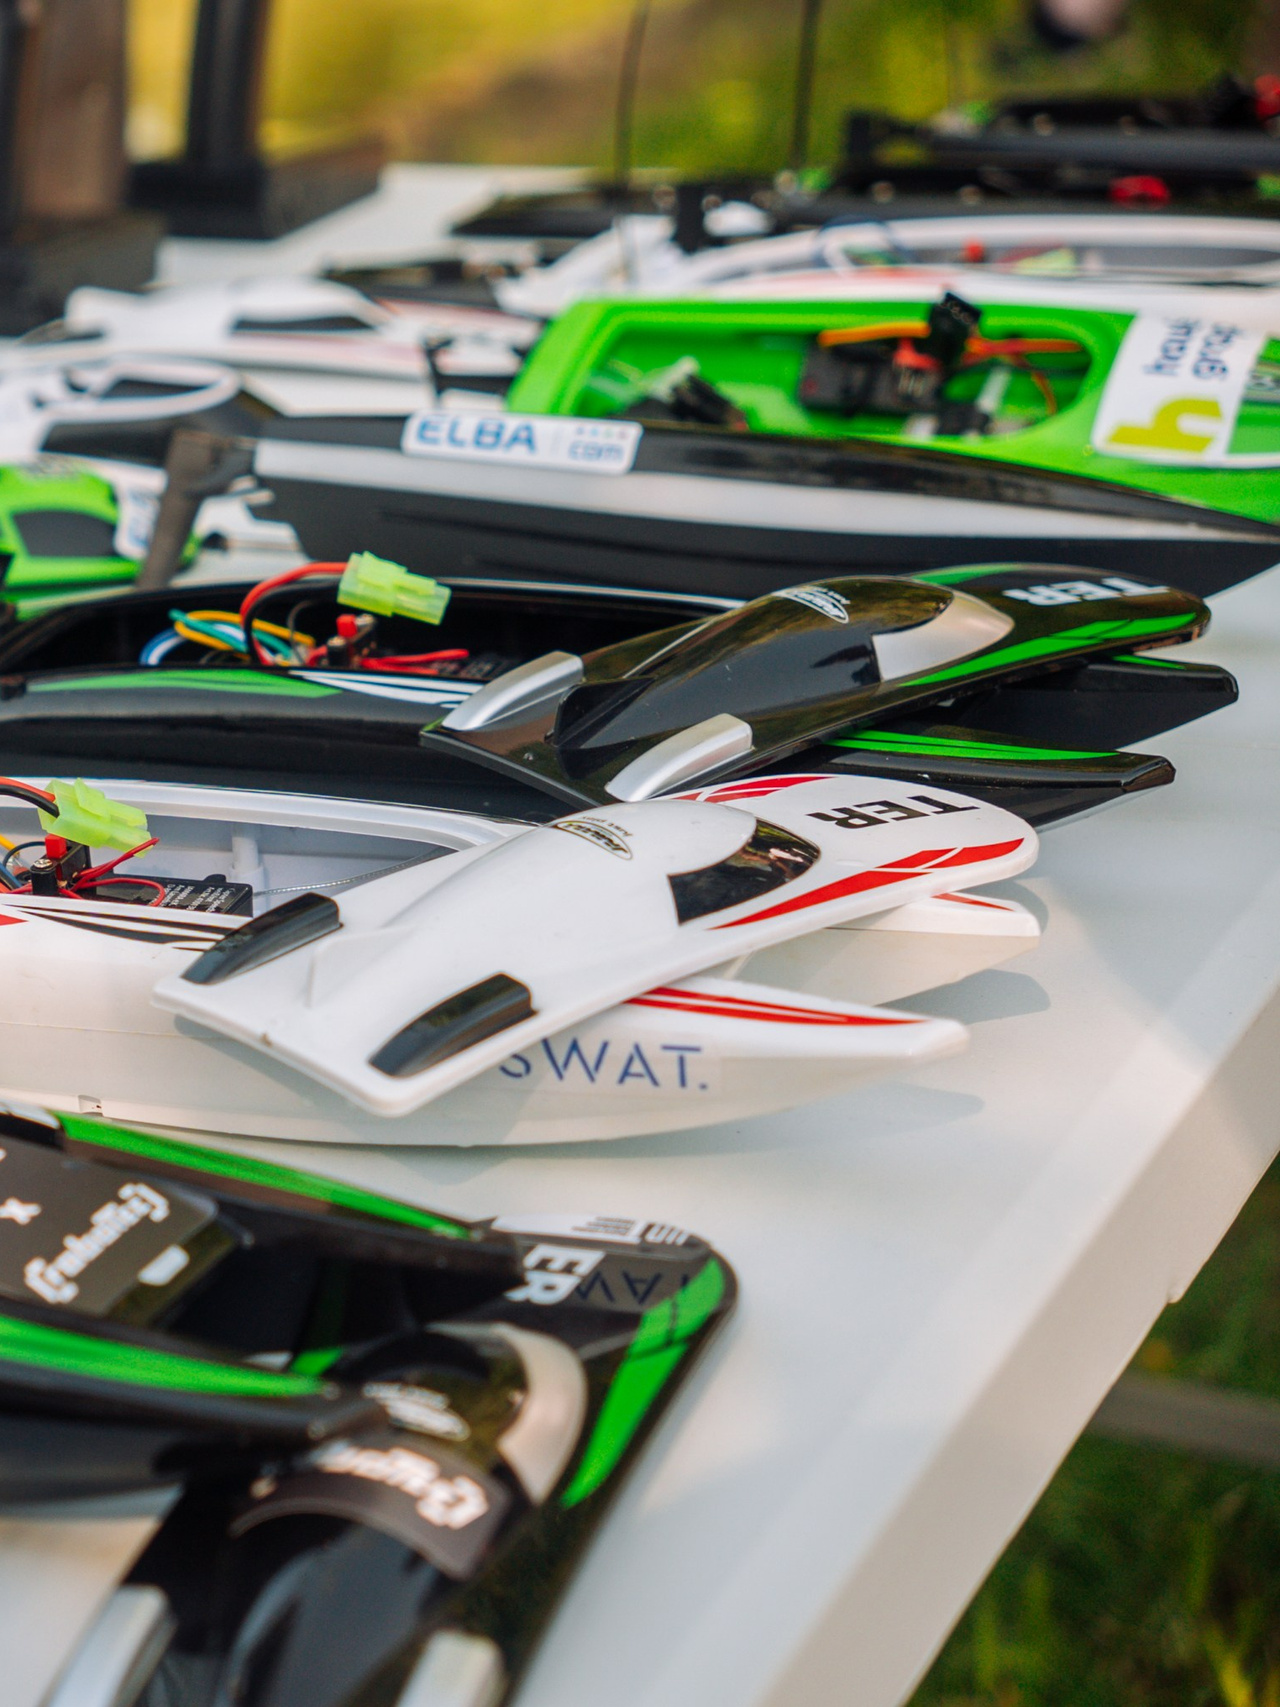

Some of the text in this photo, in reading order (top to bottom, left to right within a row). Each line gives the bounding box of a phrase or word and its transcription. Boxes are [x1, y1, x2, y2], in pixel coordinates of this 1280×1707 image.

[416, 413, 537, 454] ELBA
[1002, 577, 1170, 606] TER
[805, 794, 981, 830] TER
[497, 1036, 709, 1090] SWAT.
